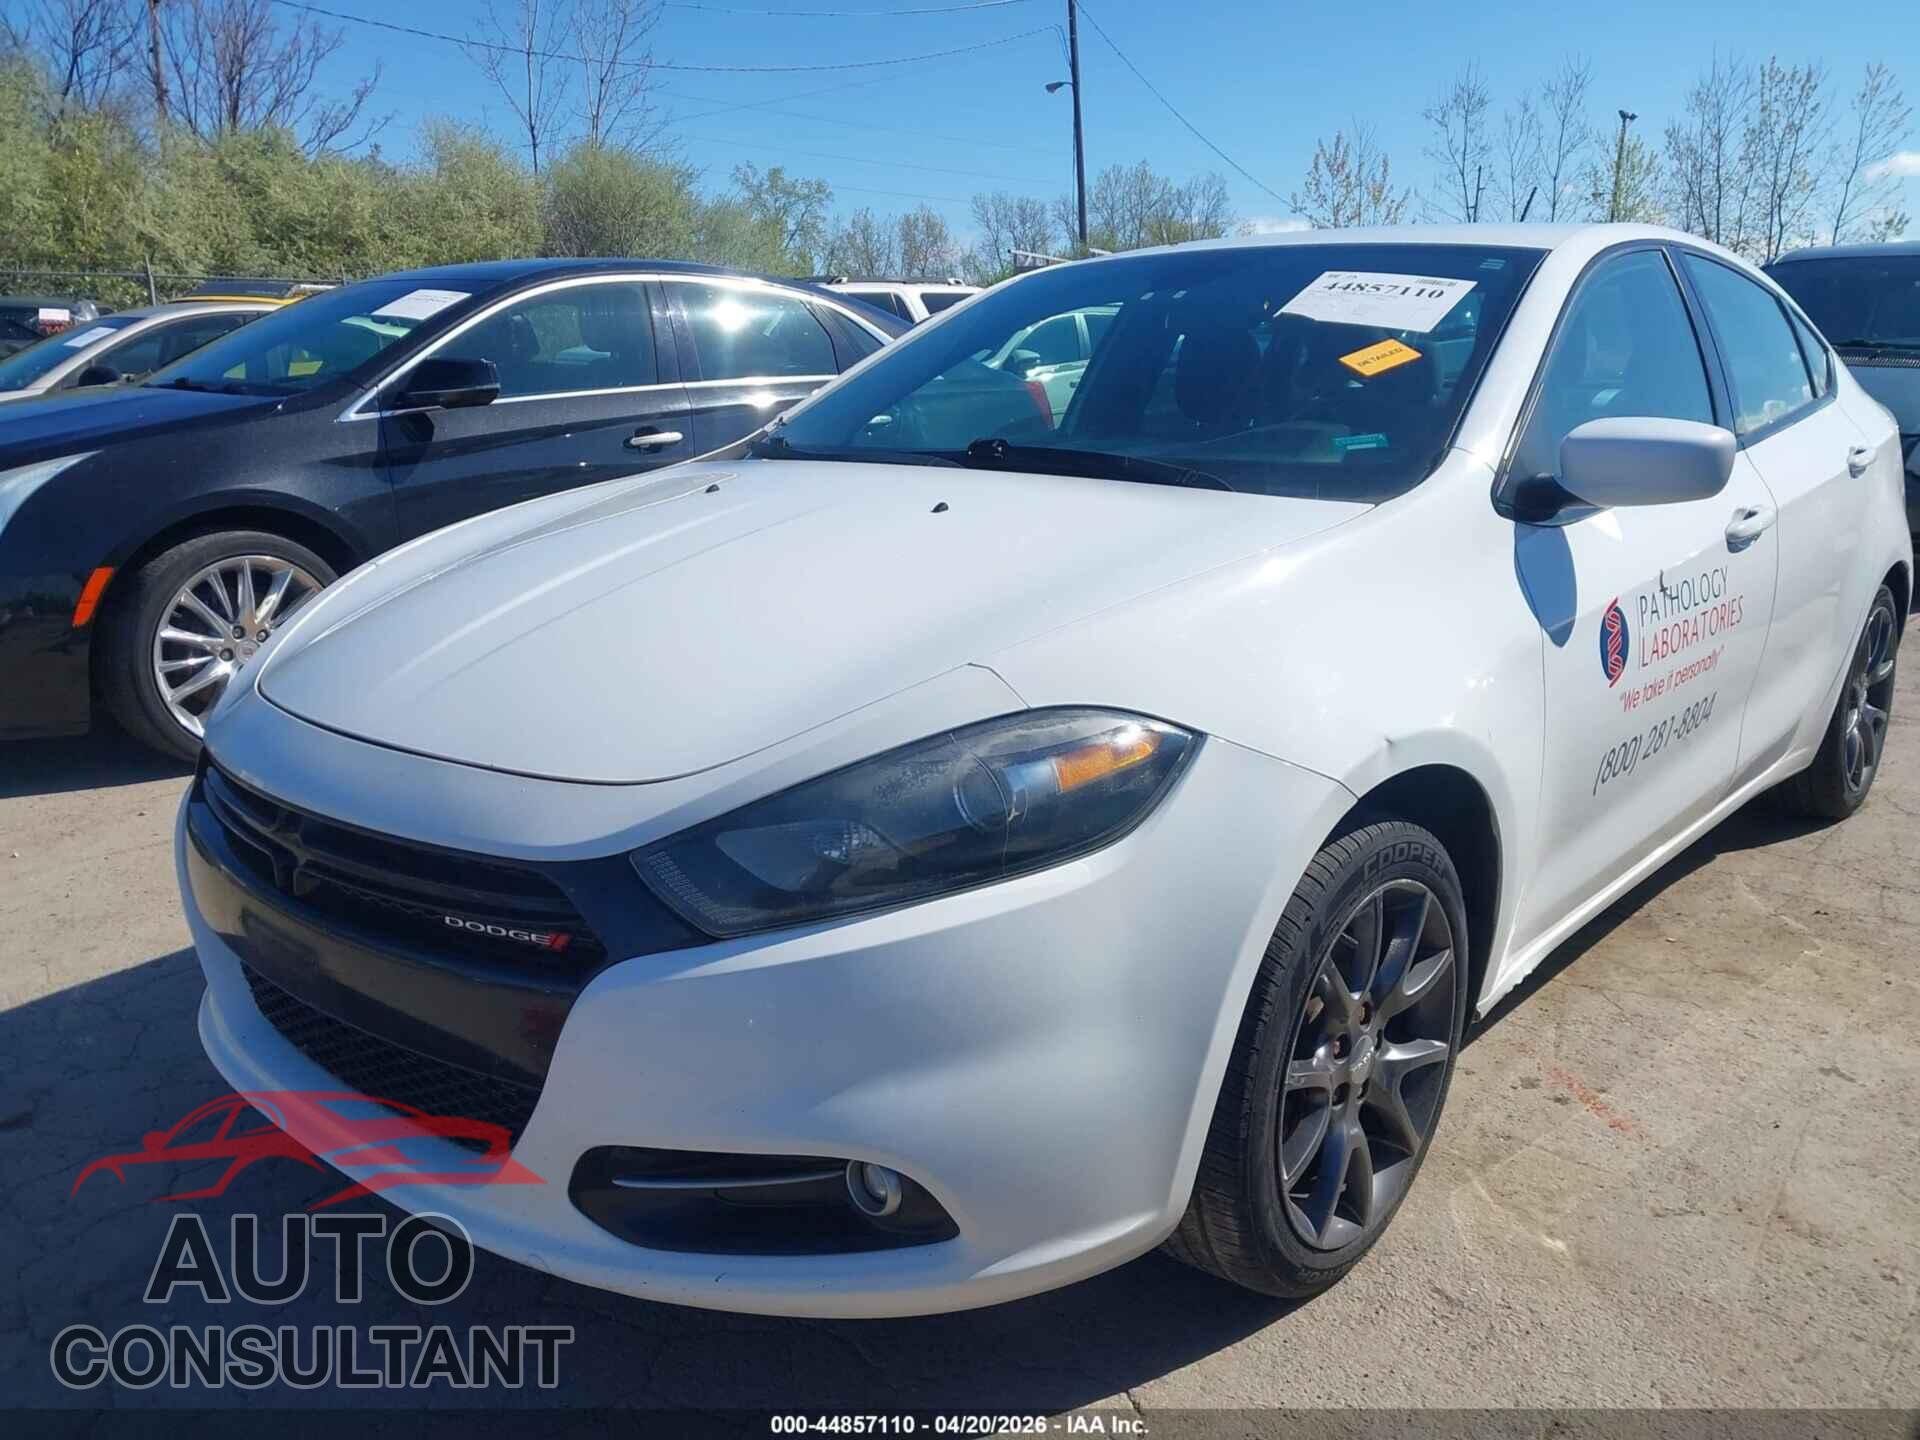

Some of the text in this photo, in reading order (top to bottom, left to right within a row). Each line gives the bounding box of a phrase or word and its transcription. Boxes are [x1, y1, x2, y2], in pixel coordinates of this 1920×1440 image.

[1323, 281, 1445, 299] 44857110
[1641, 566, 1729, 627] PATHOLOGY
[1641, 595, 1743, 668] LABORATORIES
[1642, 678, 1665, 704] take
[1593, 691, 1718, 796] (800) 281-8804
[444, 915, 551, 945] DODGE
